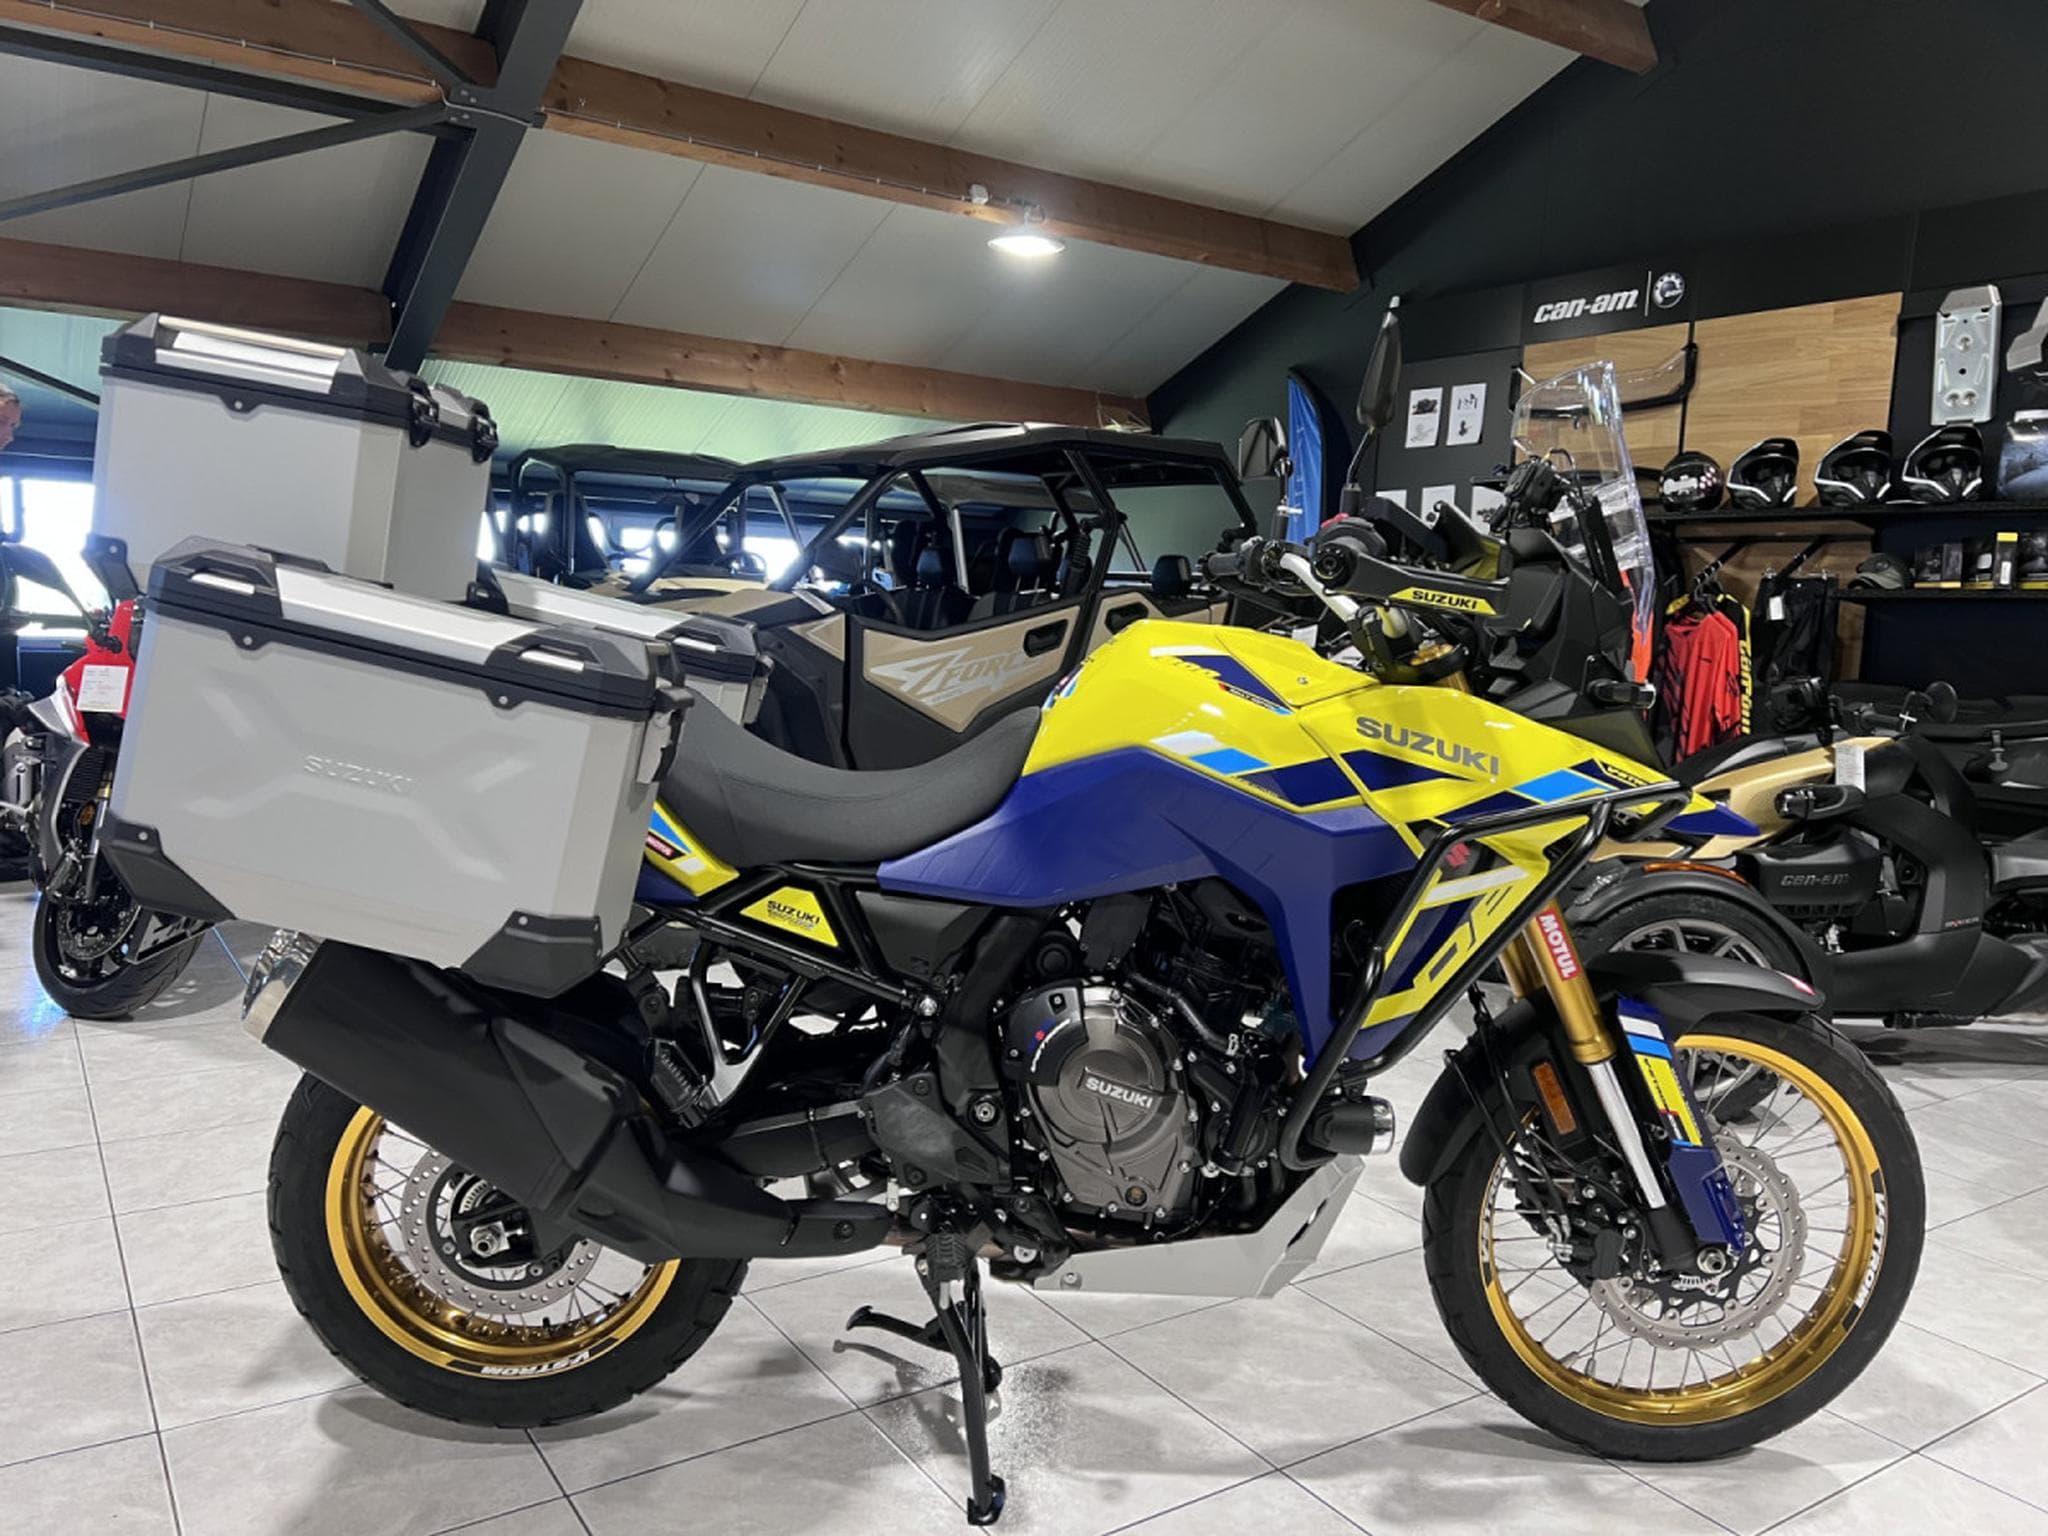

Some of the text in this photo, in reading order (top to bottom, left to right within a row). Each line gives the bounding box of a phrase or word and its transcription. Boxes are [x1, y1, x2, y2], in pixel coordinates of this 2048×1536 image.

[1533, 289, 1639, 324] can-am
[1412, 590, 1477, 610] SUZUKI
[1356, 716, 1499, 776] SUZUKI
[767, 900, 820, 925] SUZUKI
[1540, 913, 1579, 980] MOTUL
[1085, 1077, 1153, 1109] SUZUKI
